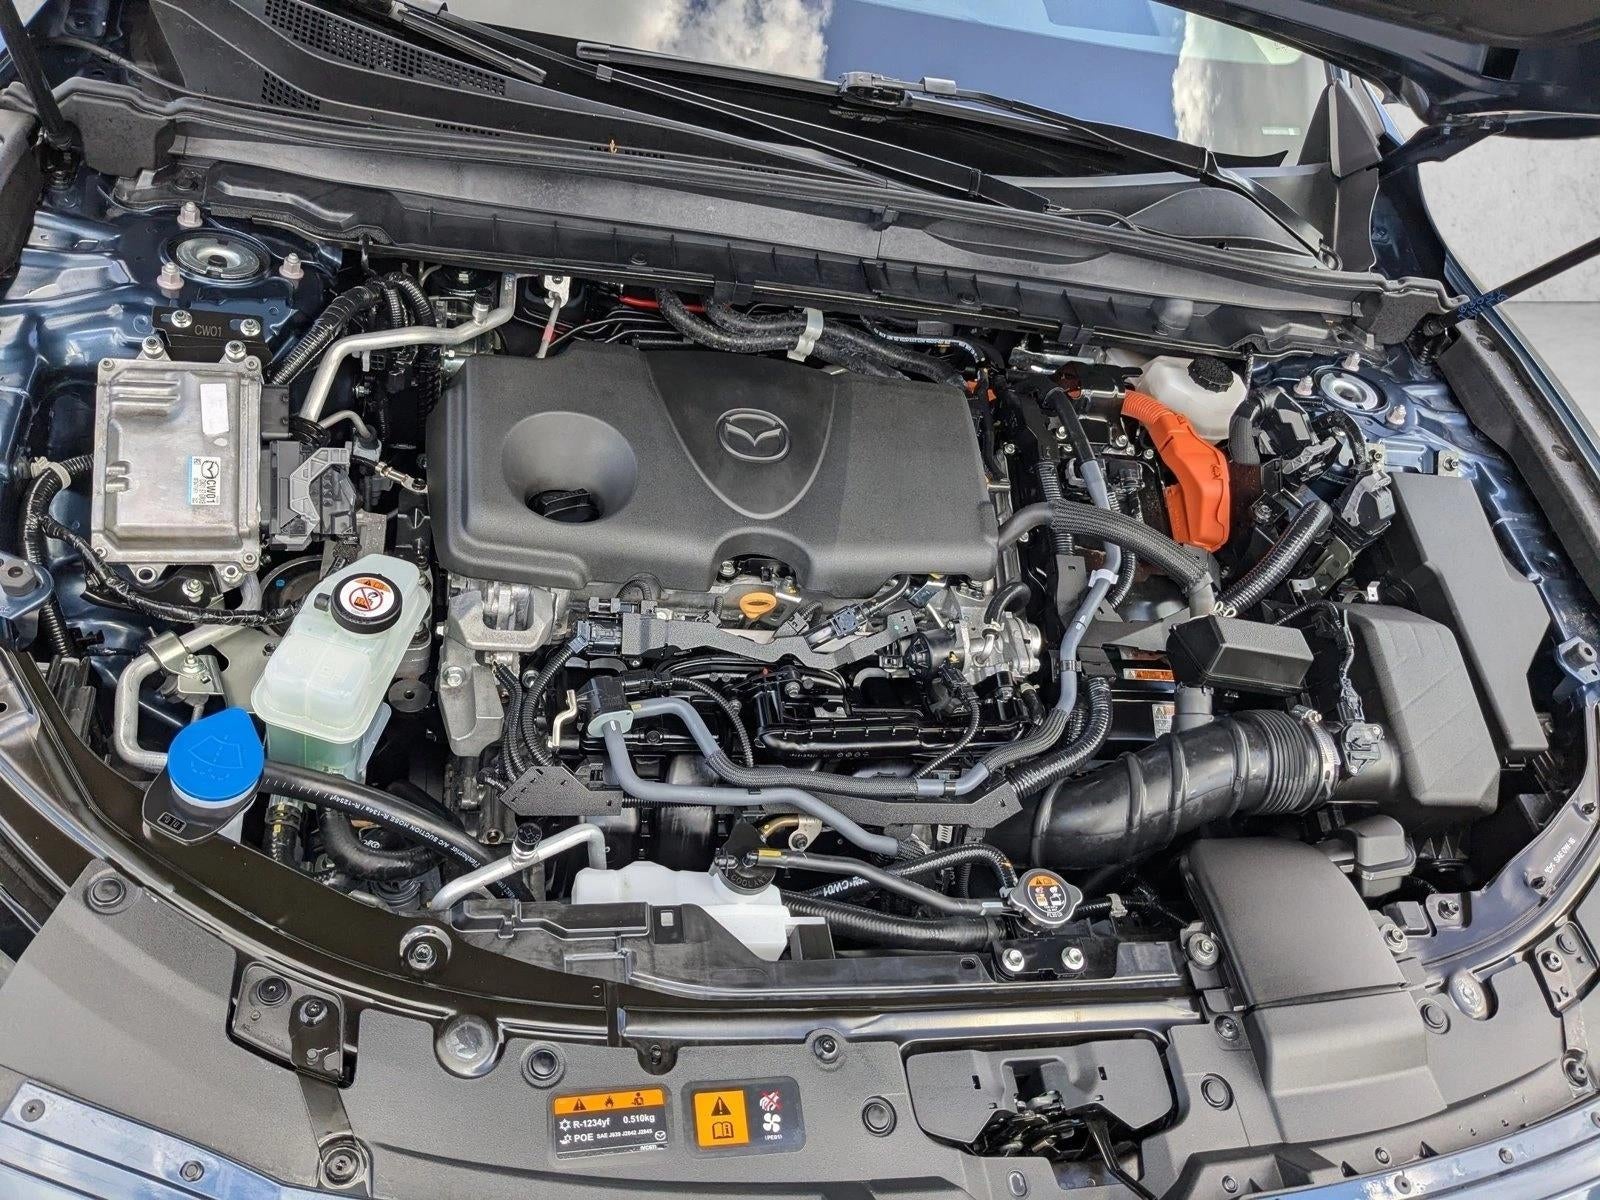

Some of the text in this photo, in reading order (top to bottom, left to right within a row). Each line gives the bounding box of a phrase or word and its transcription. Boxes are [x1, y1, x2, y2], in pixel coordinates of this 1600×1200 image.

[194, 325, 222, 336] CW01
[206, 480, 216, 503] CW01
[390, 816, 409, 828] HOSE
[410, 825, 438, 842] SUCTION
[823, 880, 849, 897] CW01
[573, 1114, 655, 1128] R-1234yf 0.510kg
[574, 1133, 594, 1142] POE
